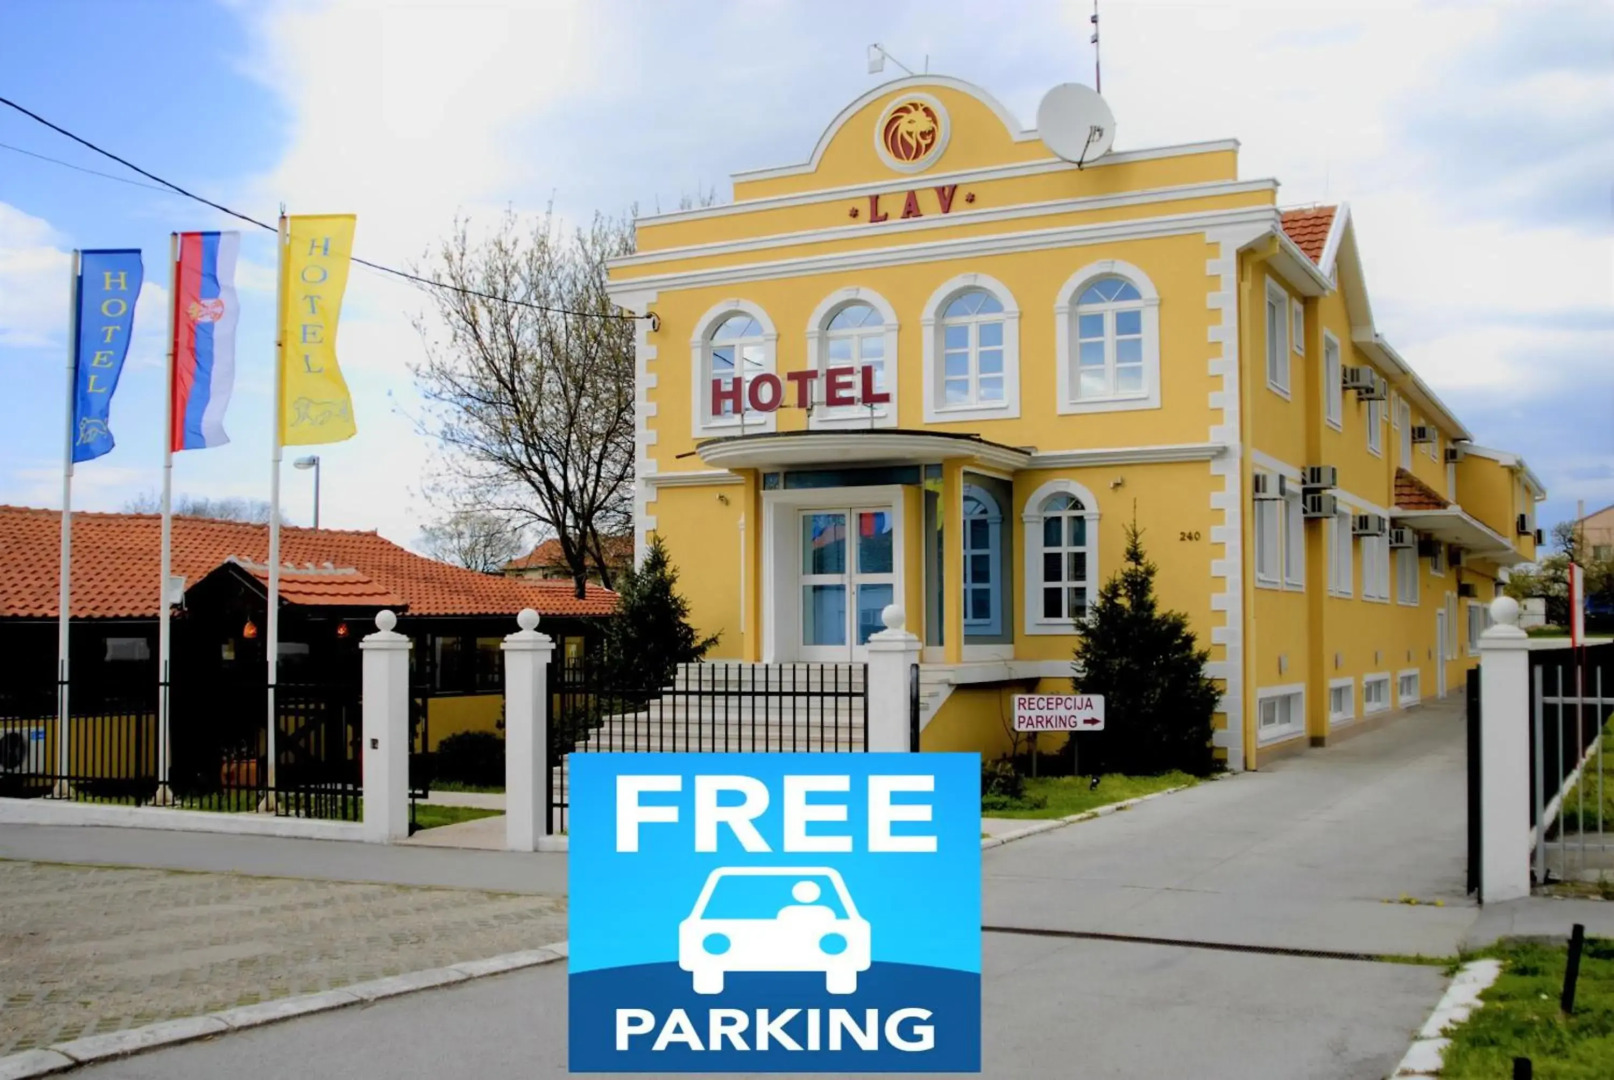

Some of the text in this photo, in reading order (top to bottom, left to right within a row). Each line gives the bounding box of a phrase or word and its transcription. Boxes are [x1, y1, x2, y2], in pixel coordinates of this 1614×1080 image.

[868, 184, 957, 223] LAV
[300, 237, 330, 374] HOTEL
[87, 271, 128, 394] HOTEL
[711, 365, 890, 416] HOTEL
[1179, 531, 1201, 541] 240
[1017, 697, 1094, 711] RECEPCIJA
[1017, 715, 1078, 729] PARKING
